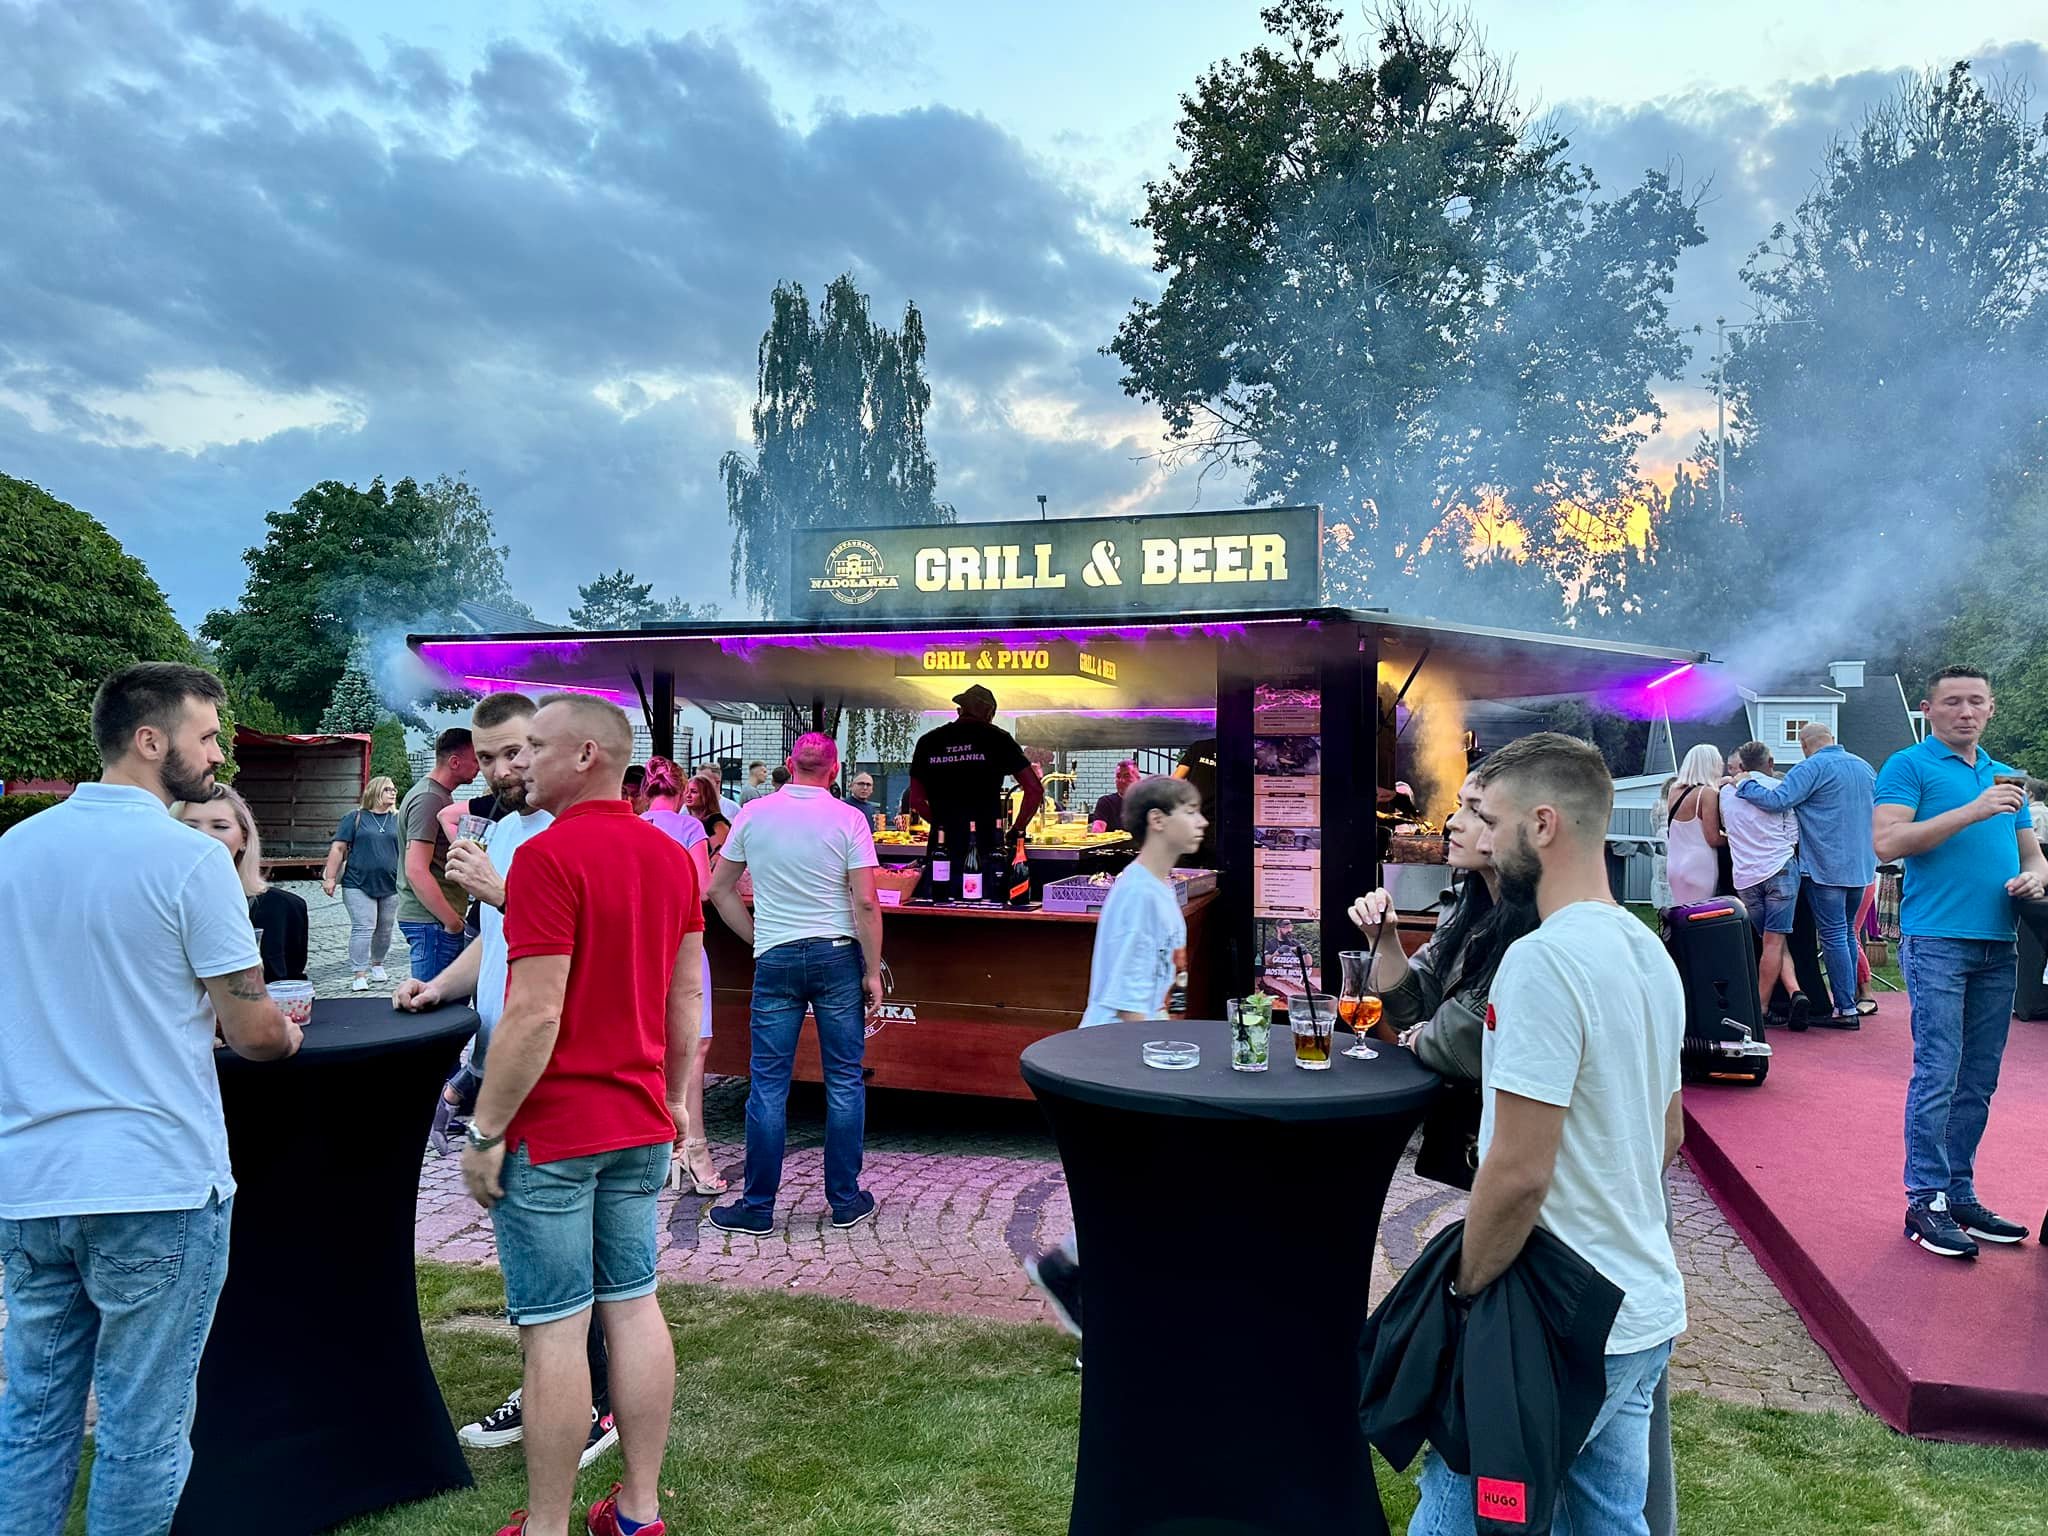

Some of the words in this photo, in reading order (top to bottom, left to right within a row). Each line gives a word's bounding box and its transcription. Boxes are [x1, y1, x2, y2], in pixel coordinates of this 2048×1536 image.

[915, 543, 1066, 592] GRILL
[1082, 540, 1123, 587] &
[1141, 533, 1288, 585] BEER
[811, 578, 899, 589] NADOLANKA
[923, 651, 971, 670] GRIL
[976, 650, 993, 670] &
[997, 650, 1049, 669] PIVO
[1079, 652, 1096, 675] GRILL
[1102, 659, 1116, 681] BEER
[946, 744, 972, 753] TEAM
[930, 753, 986, 764] NADOLANKA
[1484, 1492, 1517, 1507] HUGO
